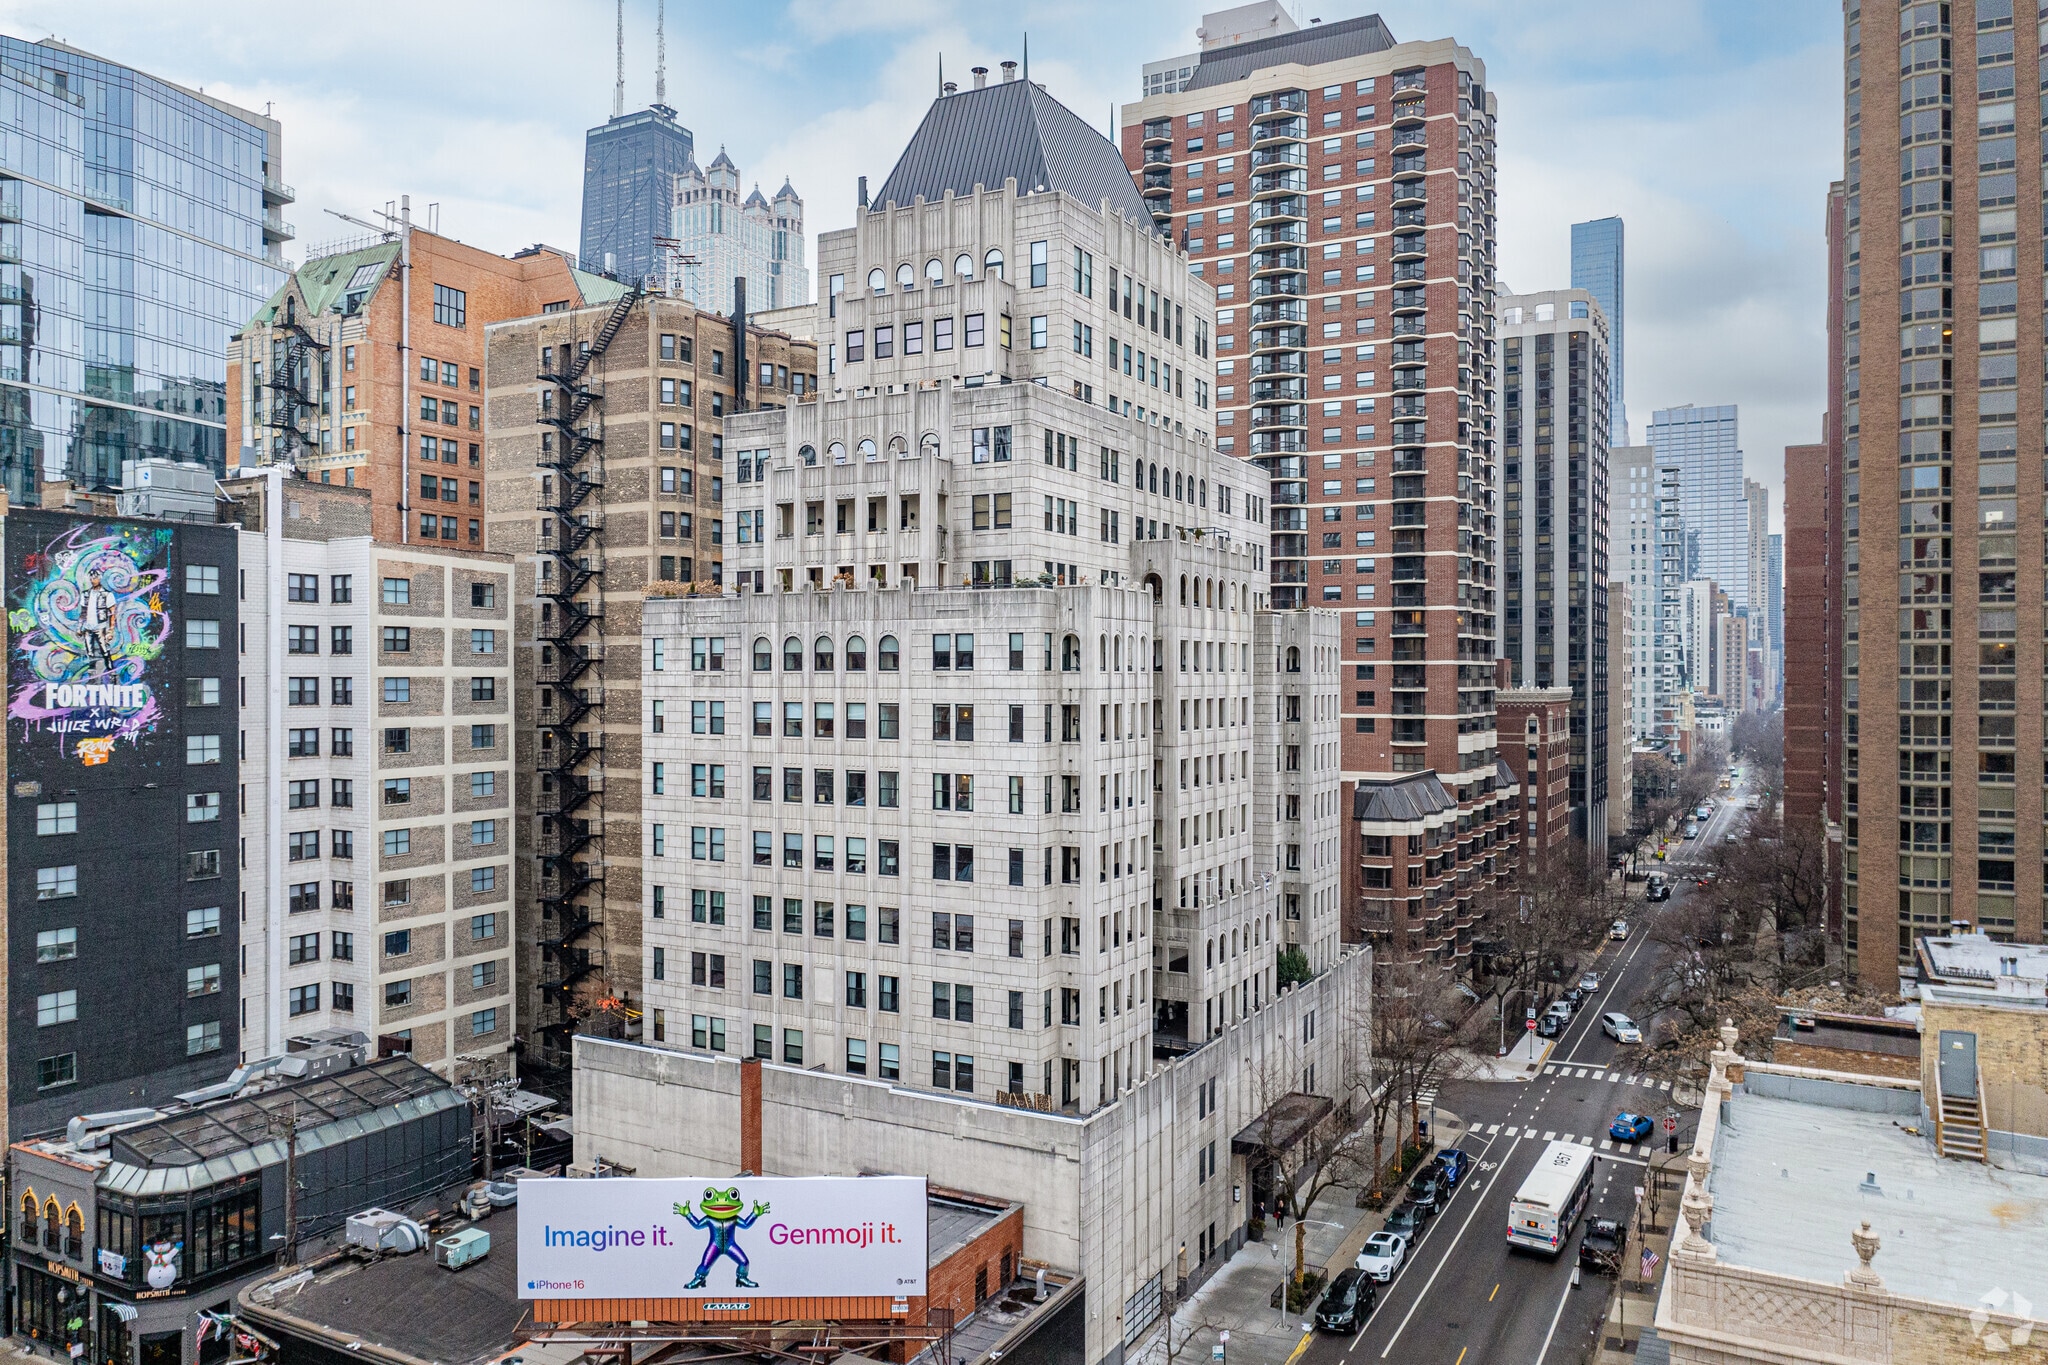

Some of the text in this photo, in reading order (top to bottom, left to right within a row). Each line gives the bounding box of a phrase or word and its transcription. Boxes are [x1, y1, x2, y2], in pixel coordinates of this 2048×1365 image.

[45, 683, 144, 710] FORTNITE
[46, 717, 140, 733] JUICE WRLD
[545, 1222, 902, 1251] Imagine it. Genmoji it.
[48, 1260, 79, 1282] HOPSMITH
[136, 1288, 170, 1299] HOPSMITH
[536, 1280, 572, 1290] iPhone
[573, 1280, 585, 1290] 16
